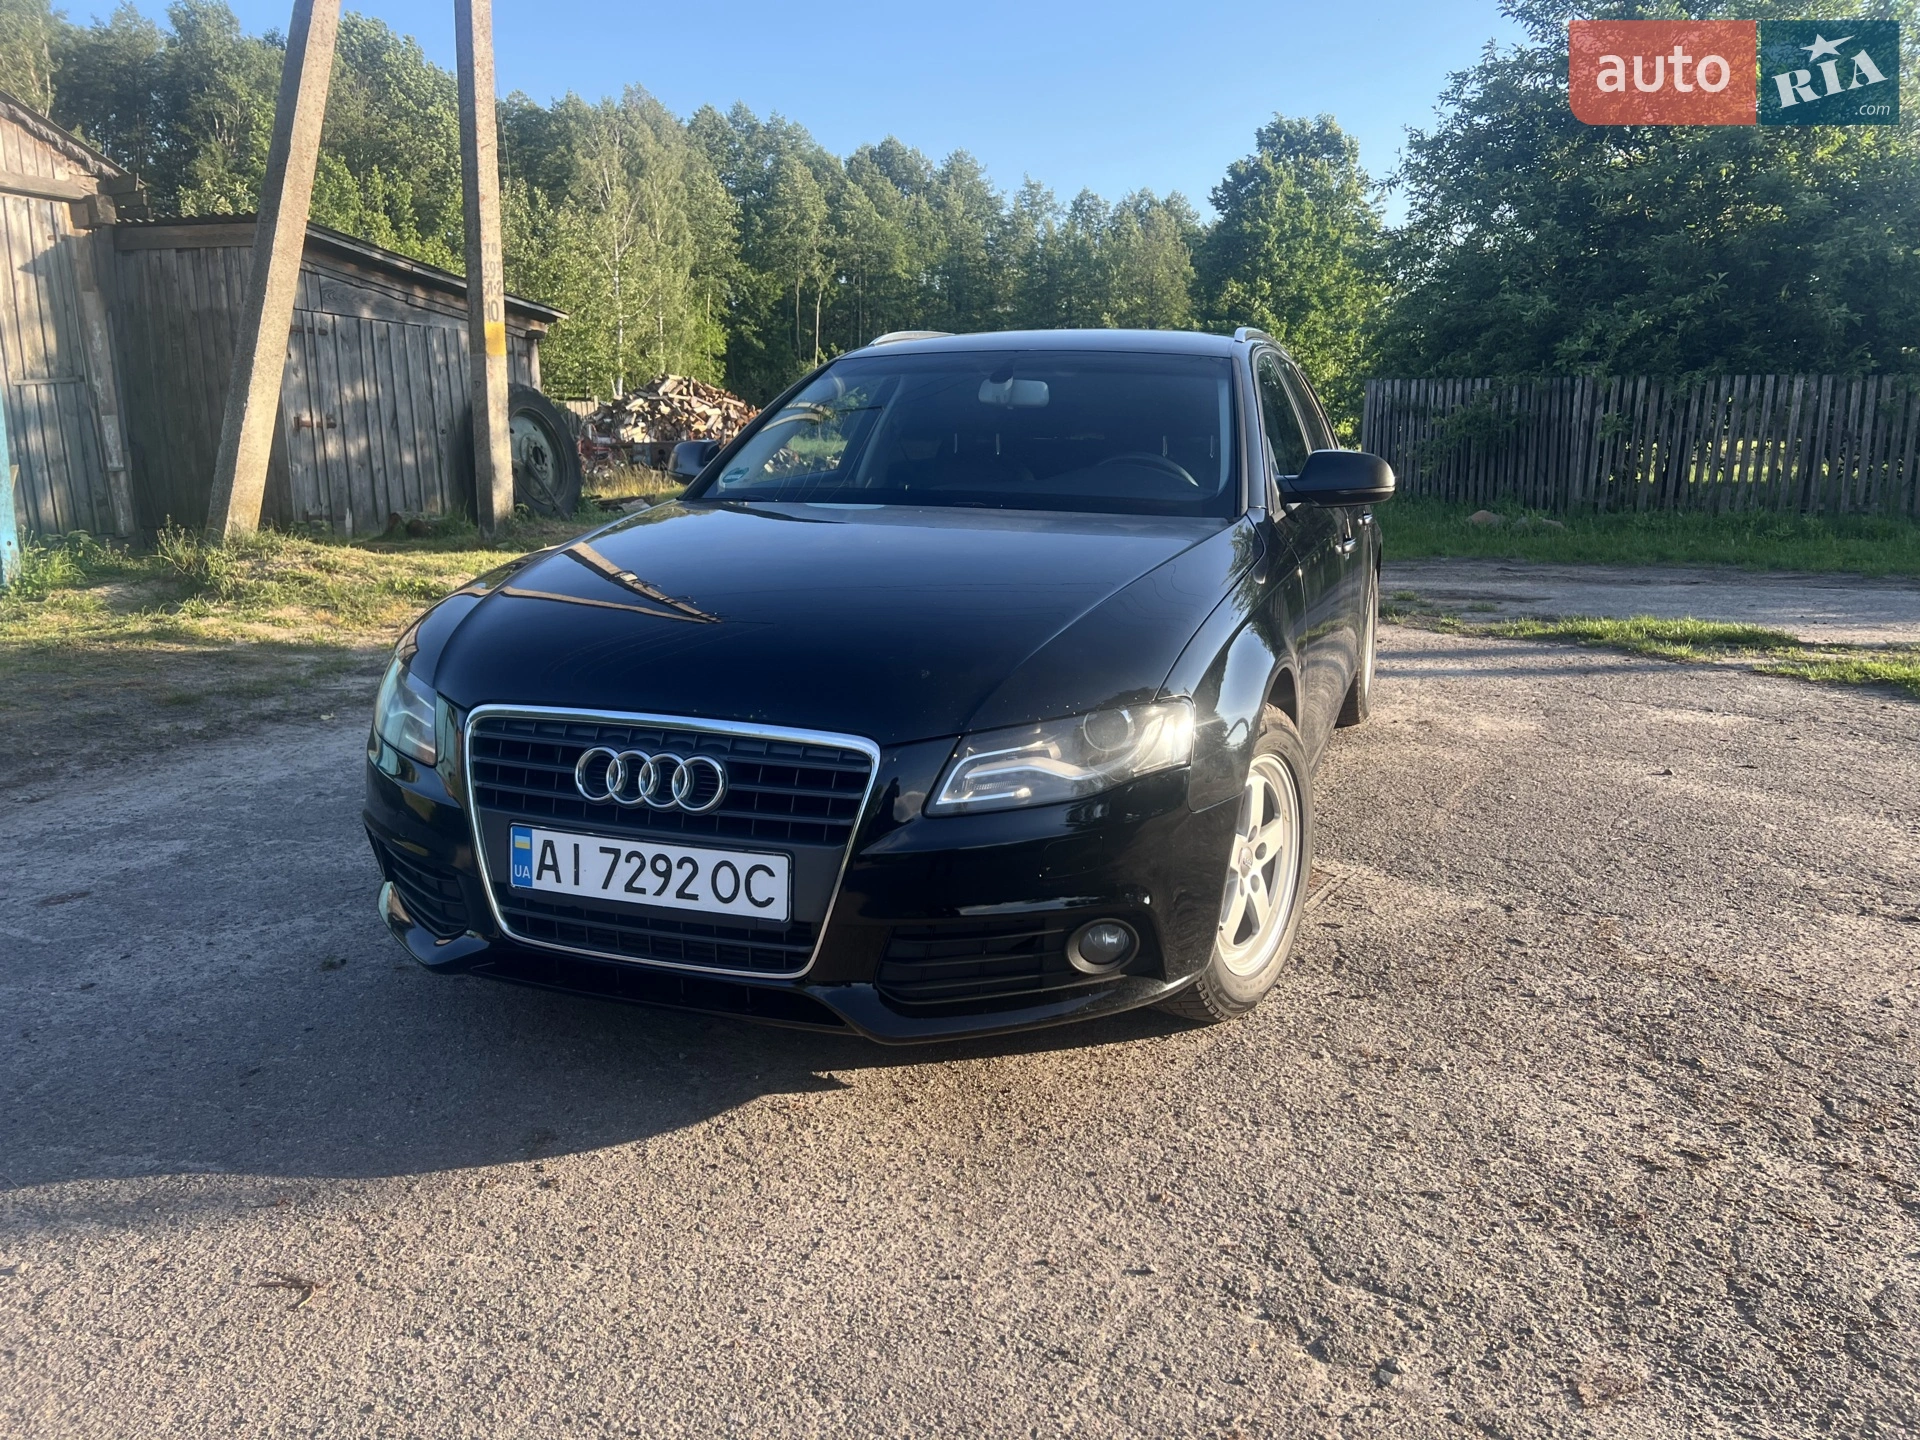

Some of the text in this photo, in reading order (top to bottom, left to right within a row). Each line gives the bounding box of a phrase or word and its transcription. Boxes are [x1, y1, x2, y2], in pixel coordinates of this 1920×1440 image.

[514, 864, 531, 879] UA
[536, 839, 776, 908] AI 7292 OC
